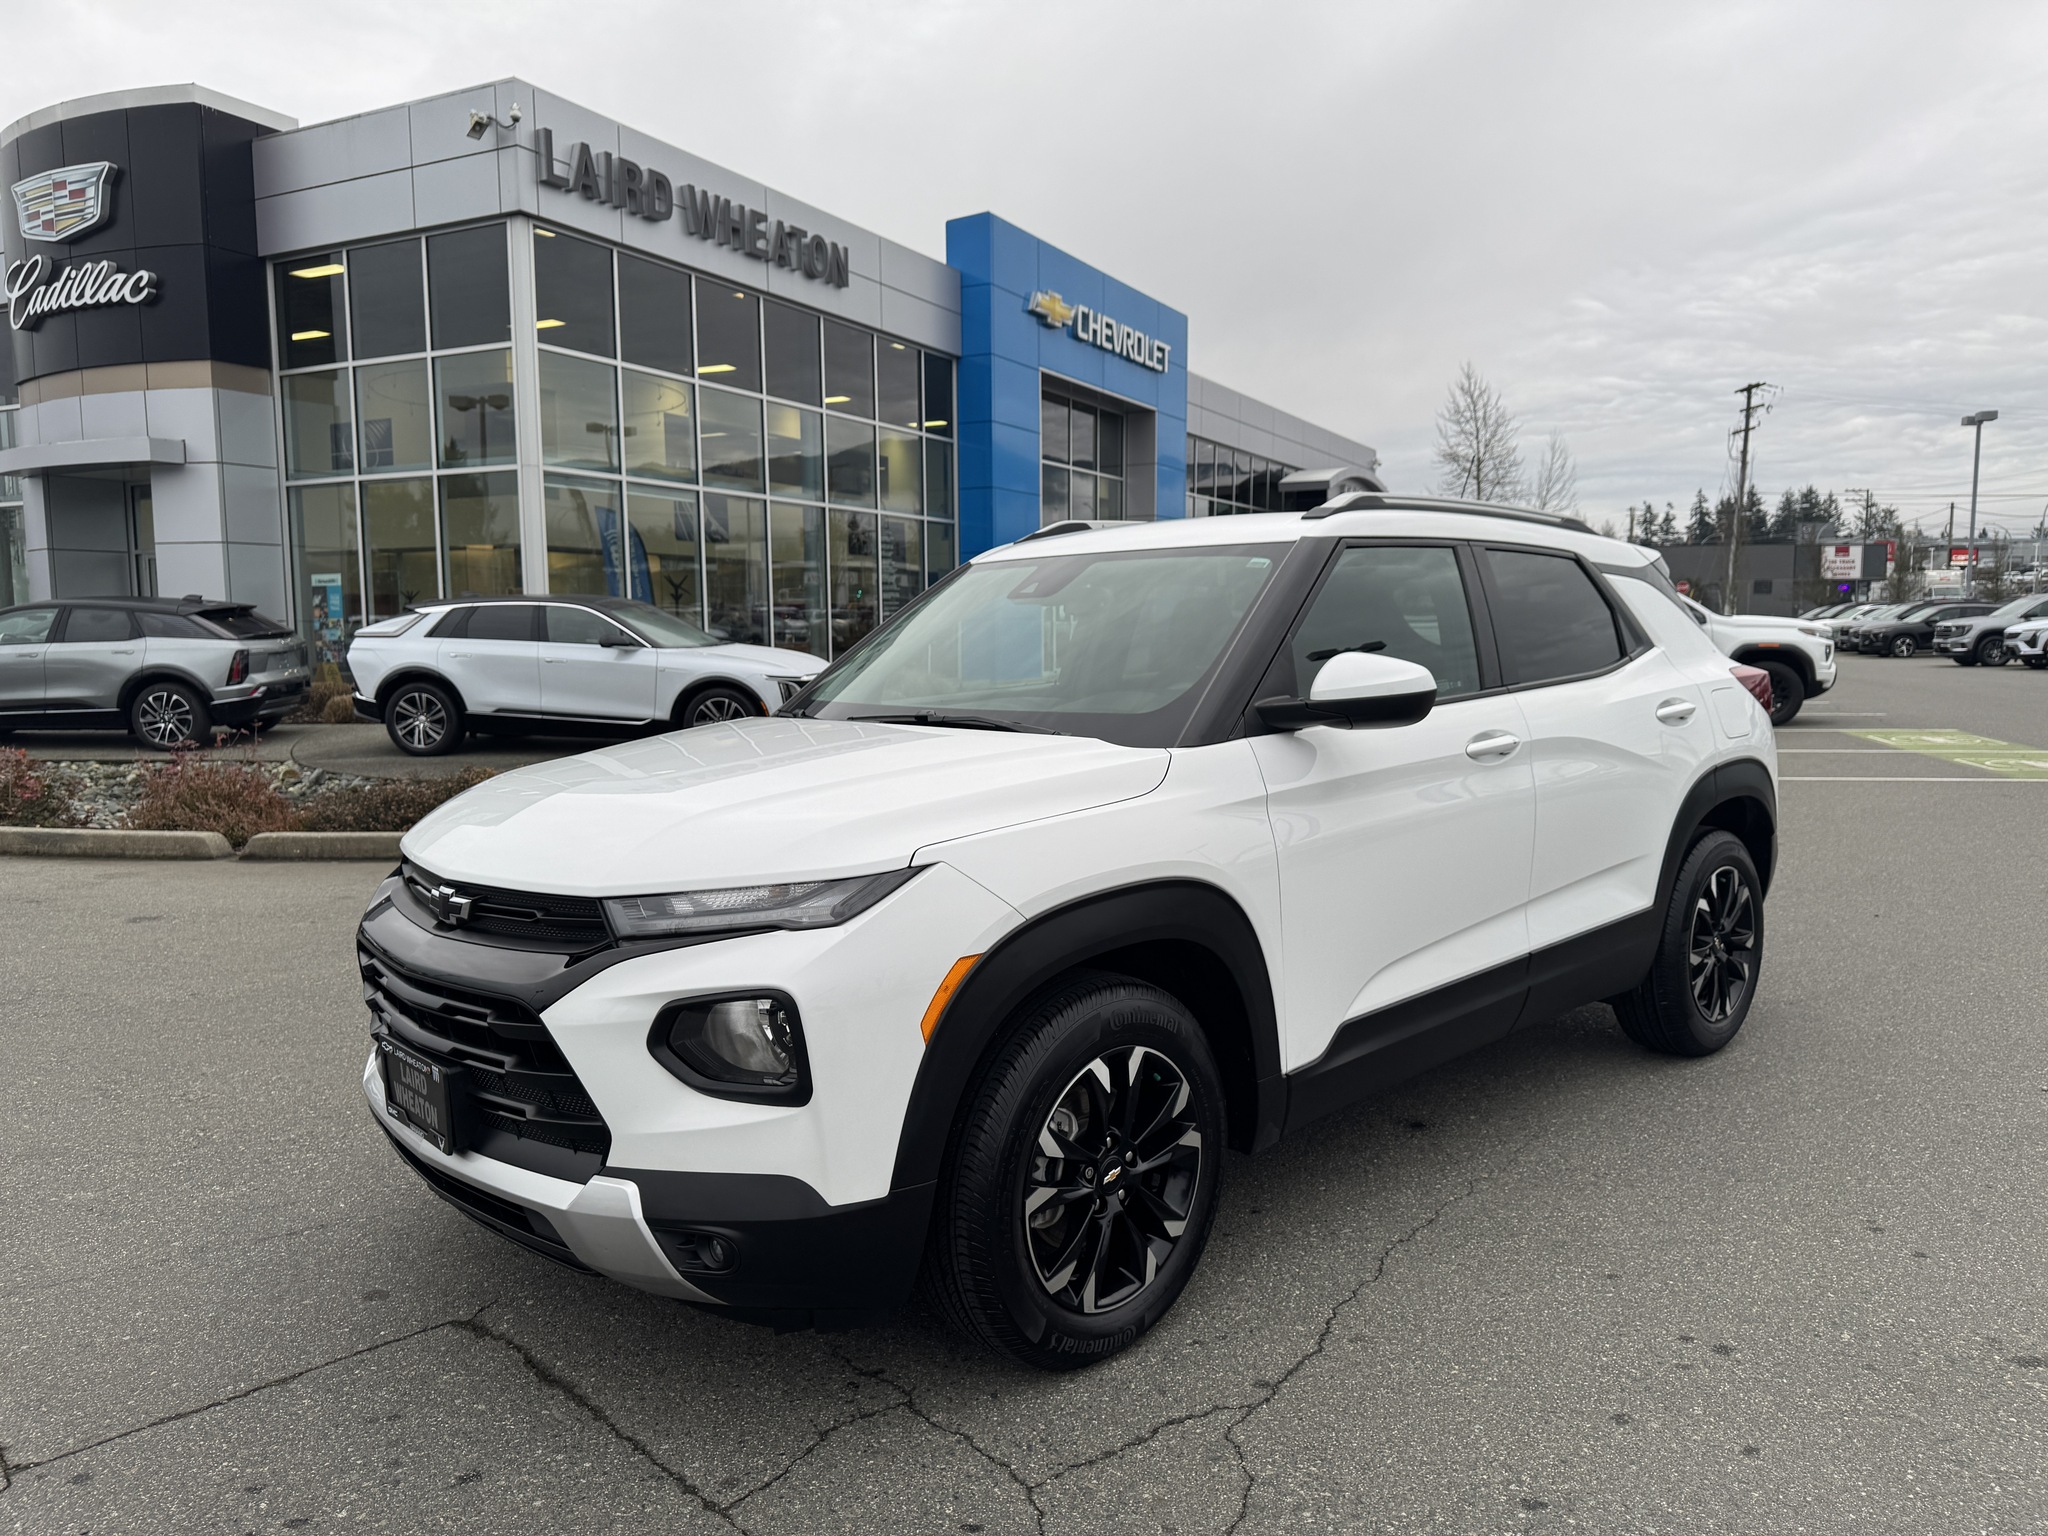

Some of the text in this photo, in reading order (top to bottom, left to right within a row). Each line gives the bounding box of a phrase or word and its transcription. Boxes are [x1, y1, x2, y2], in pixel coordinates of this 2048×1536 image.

[537, 127, 849, 287] LAIRD WHEATON
[4, 254, 156, 330] Cadillac
[1076, 304, 1171, 373] CHEVROLET
[1110, 1006, 1179, 1034] Continental
[393, 1047, 406, 1061] LAIRD
[399, 1062, 427, 1095] LAIRD
[393, 1081, 438, 1129] WHEATON
[1057, 1325, 1137, 1355] Continental
